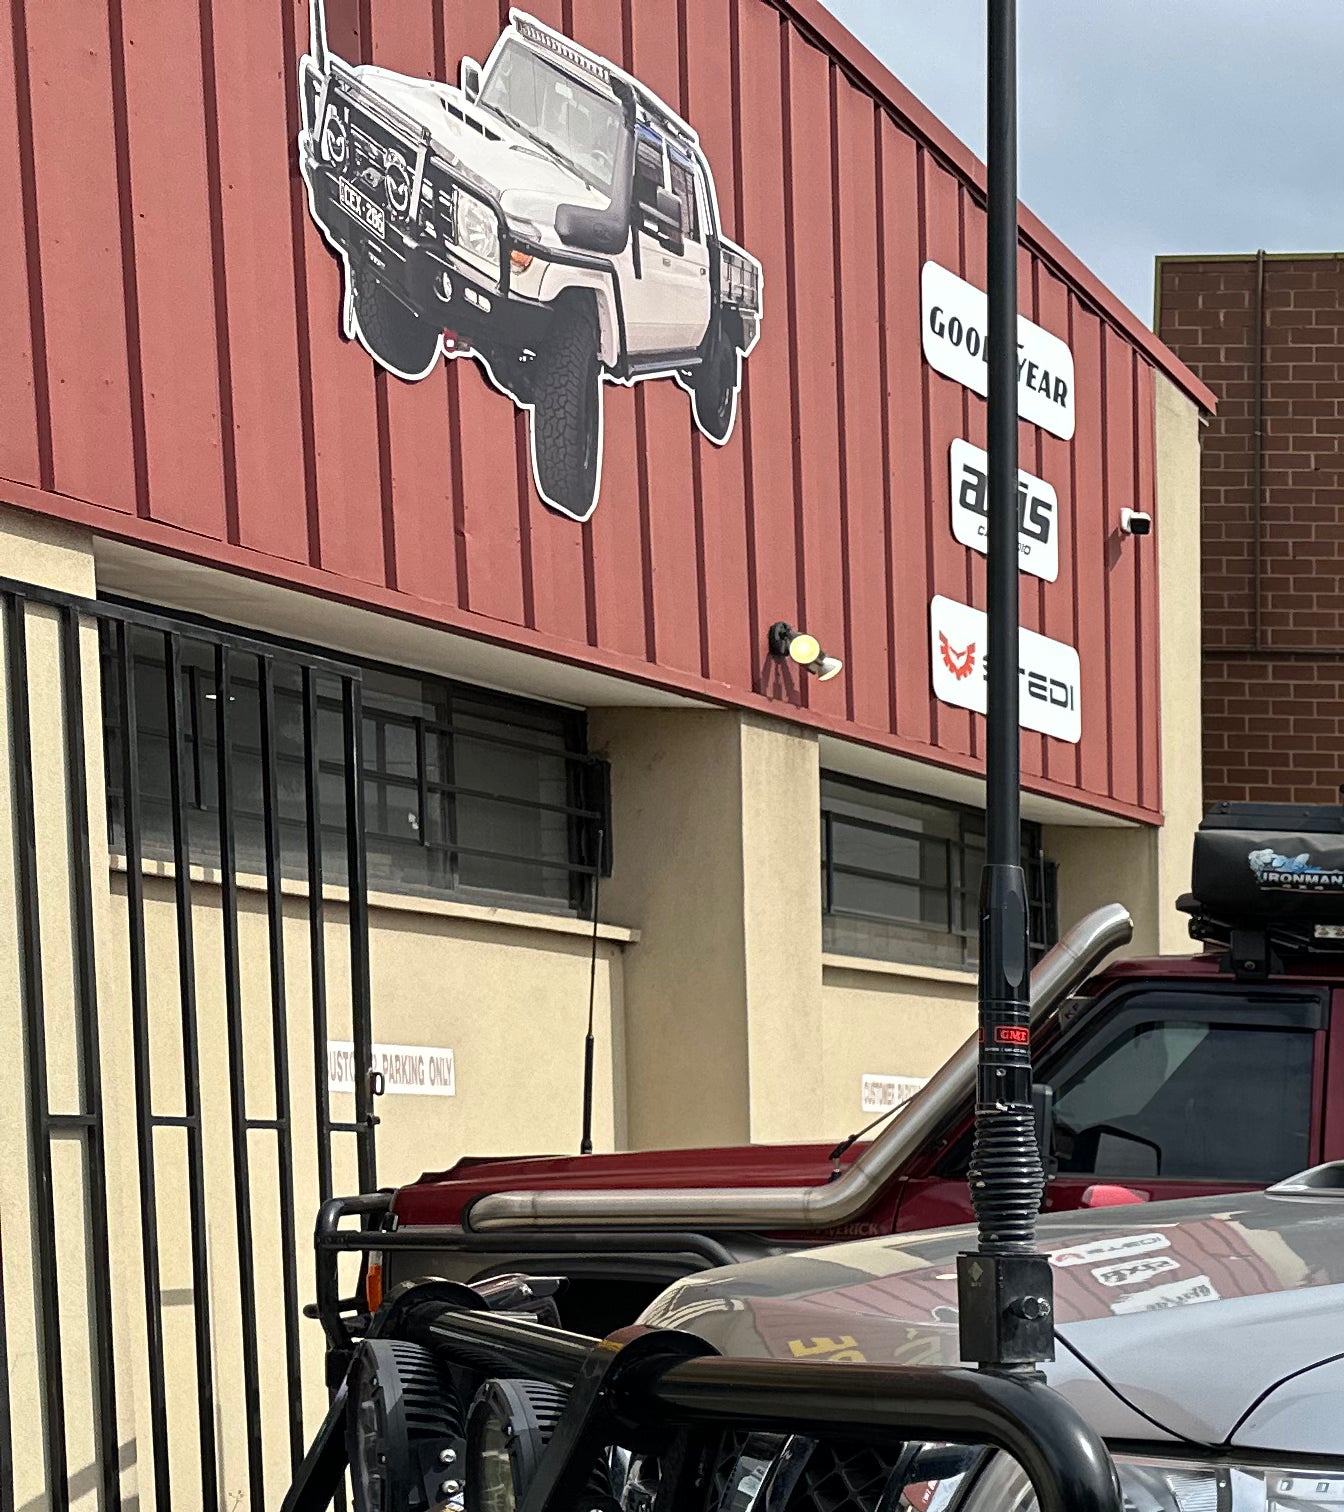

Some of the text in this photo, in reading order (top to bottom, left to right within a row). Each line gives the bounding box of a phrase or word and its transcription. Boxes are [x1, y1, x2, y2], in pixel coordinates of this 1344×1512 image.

[930, 306, 1068, 408] GOOYEAR
[959, 463, 1053, 544] ais
[983, 655, 1074, 712] EDI
[1262, 872, 1344, 884] IRONMAN
[382, 1053, 425, 1085] PARKING
[428, 1055, 452, 1086] ONLY
